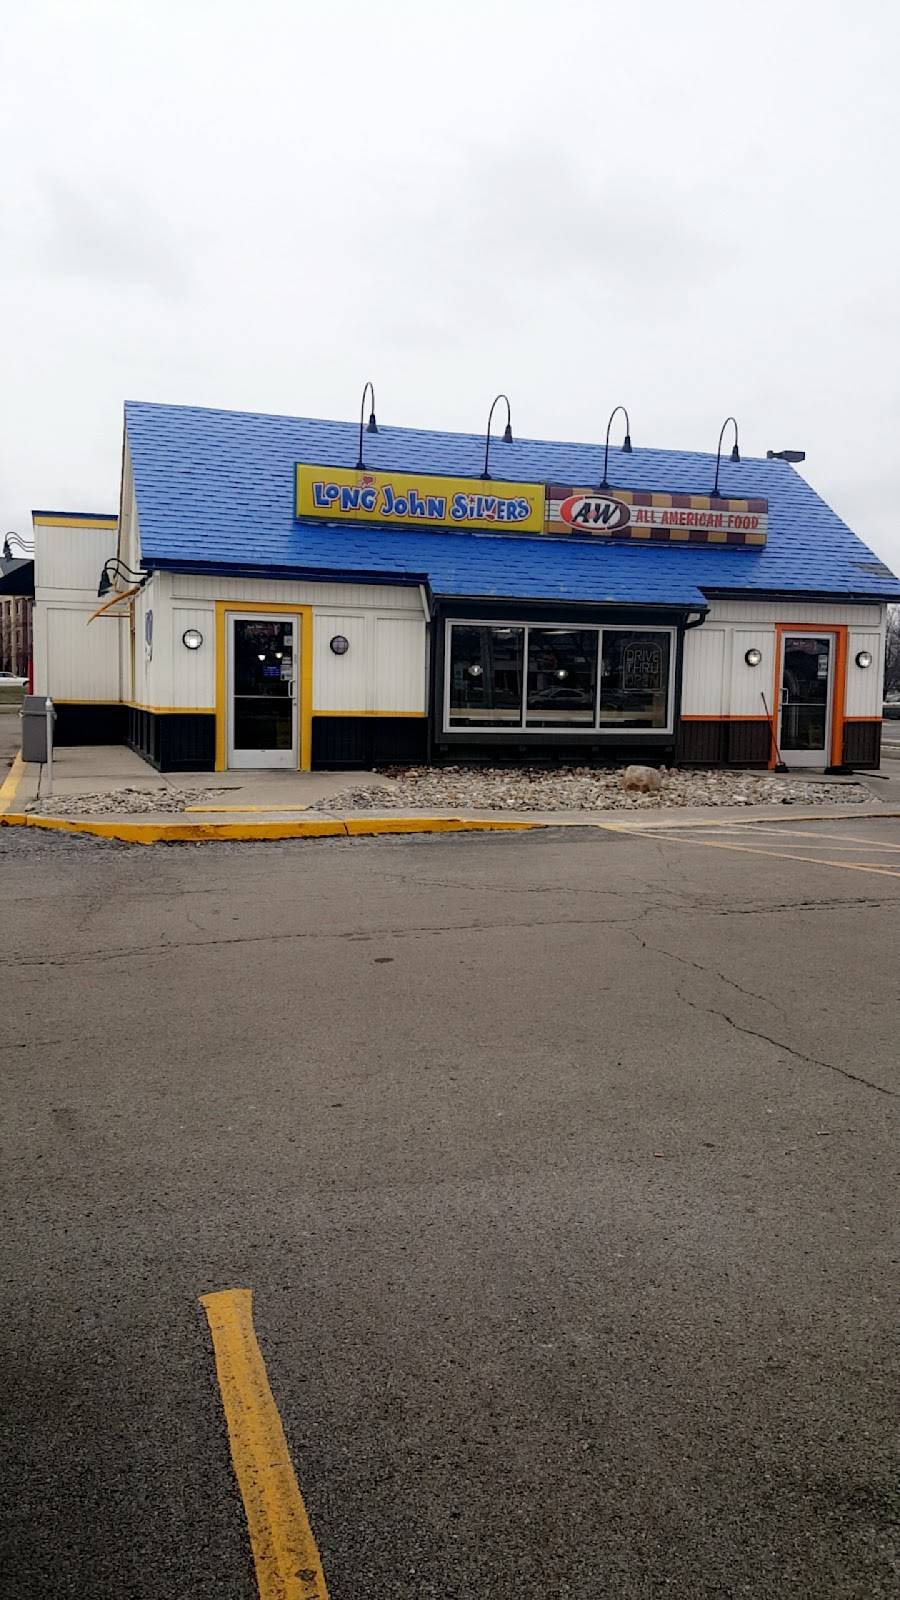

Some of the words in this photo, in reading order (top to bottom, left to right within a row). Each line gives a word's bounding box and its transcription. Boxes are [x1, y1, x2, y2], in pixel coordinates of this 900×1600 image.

[312, 481, 379, 513] LONG
[635, 508, 657, 524] ALL
[660, 510, 723, 529] AMERICAN
[727, 513, 759, 530] FOOD
[626, 648, 660, 662] DRIVE
[626, 661, 659, 674] THRU
